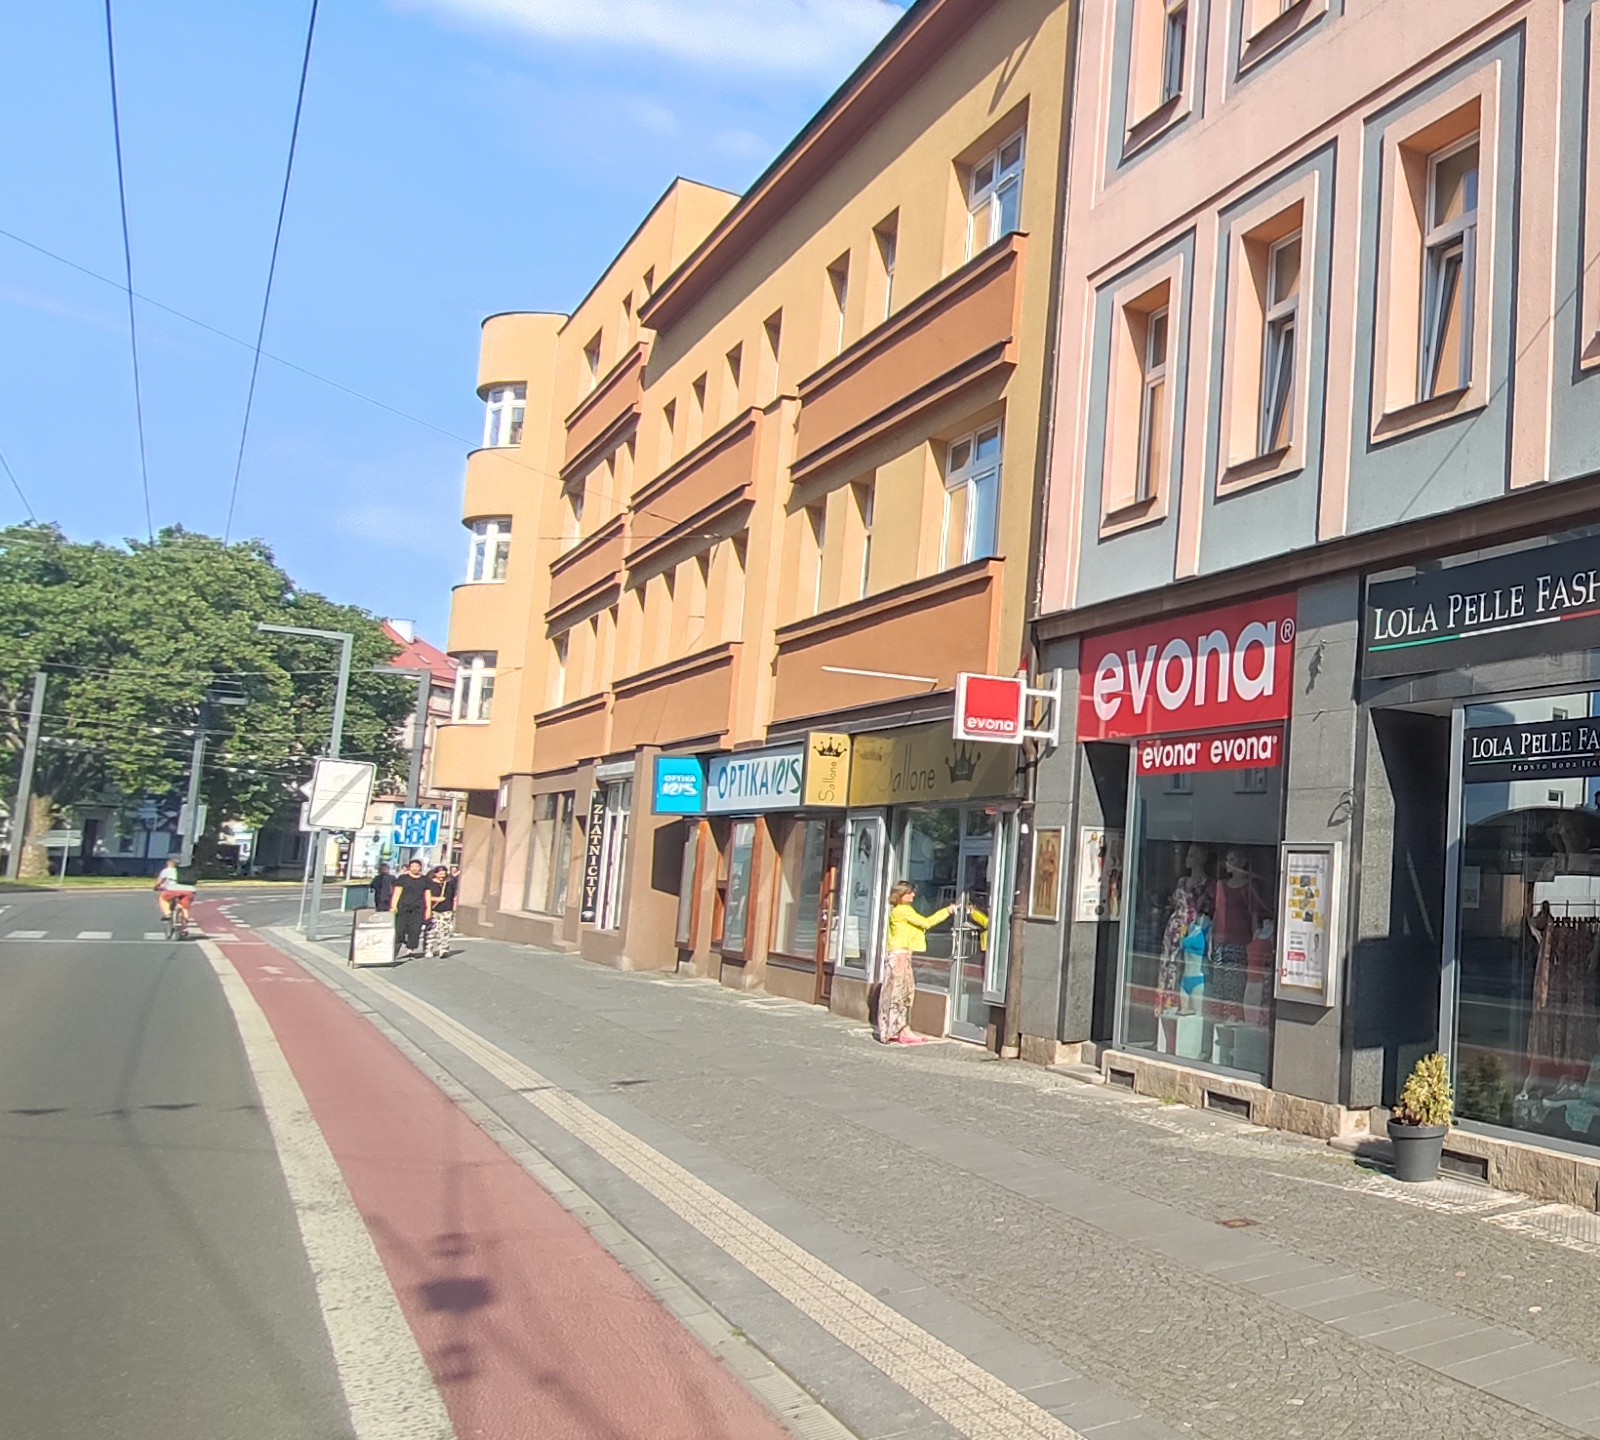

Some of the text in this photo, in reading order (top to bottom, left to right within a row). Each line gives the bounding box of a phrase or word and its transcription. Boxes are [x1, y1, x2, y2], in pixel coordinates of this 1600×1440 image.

[1373, 604, 1440, 640] LOLA
[1446, 584, 1526, 630] PELLE
[966, 715, 1016, 732] evona
[1471, 735, 1514, 759] LOLA
[1520, 729, 1573, 755] PELLE
[717, 763, 769, 799] OPTIKA
